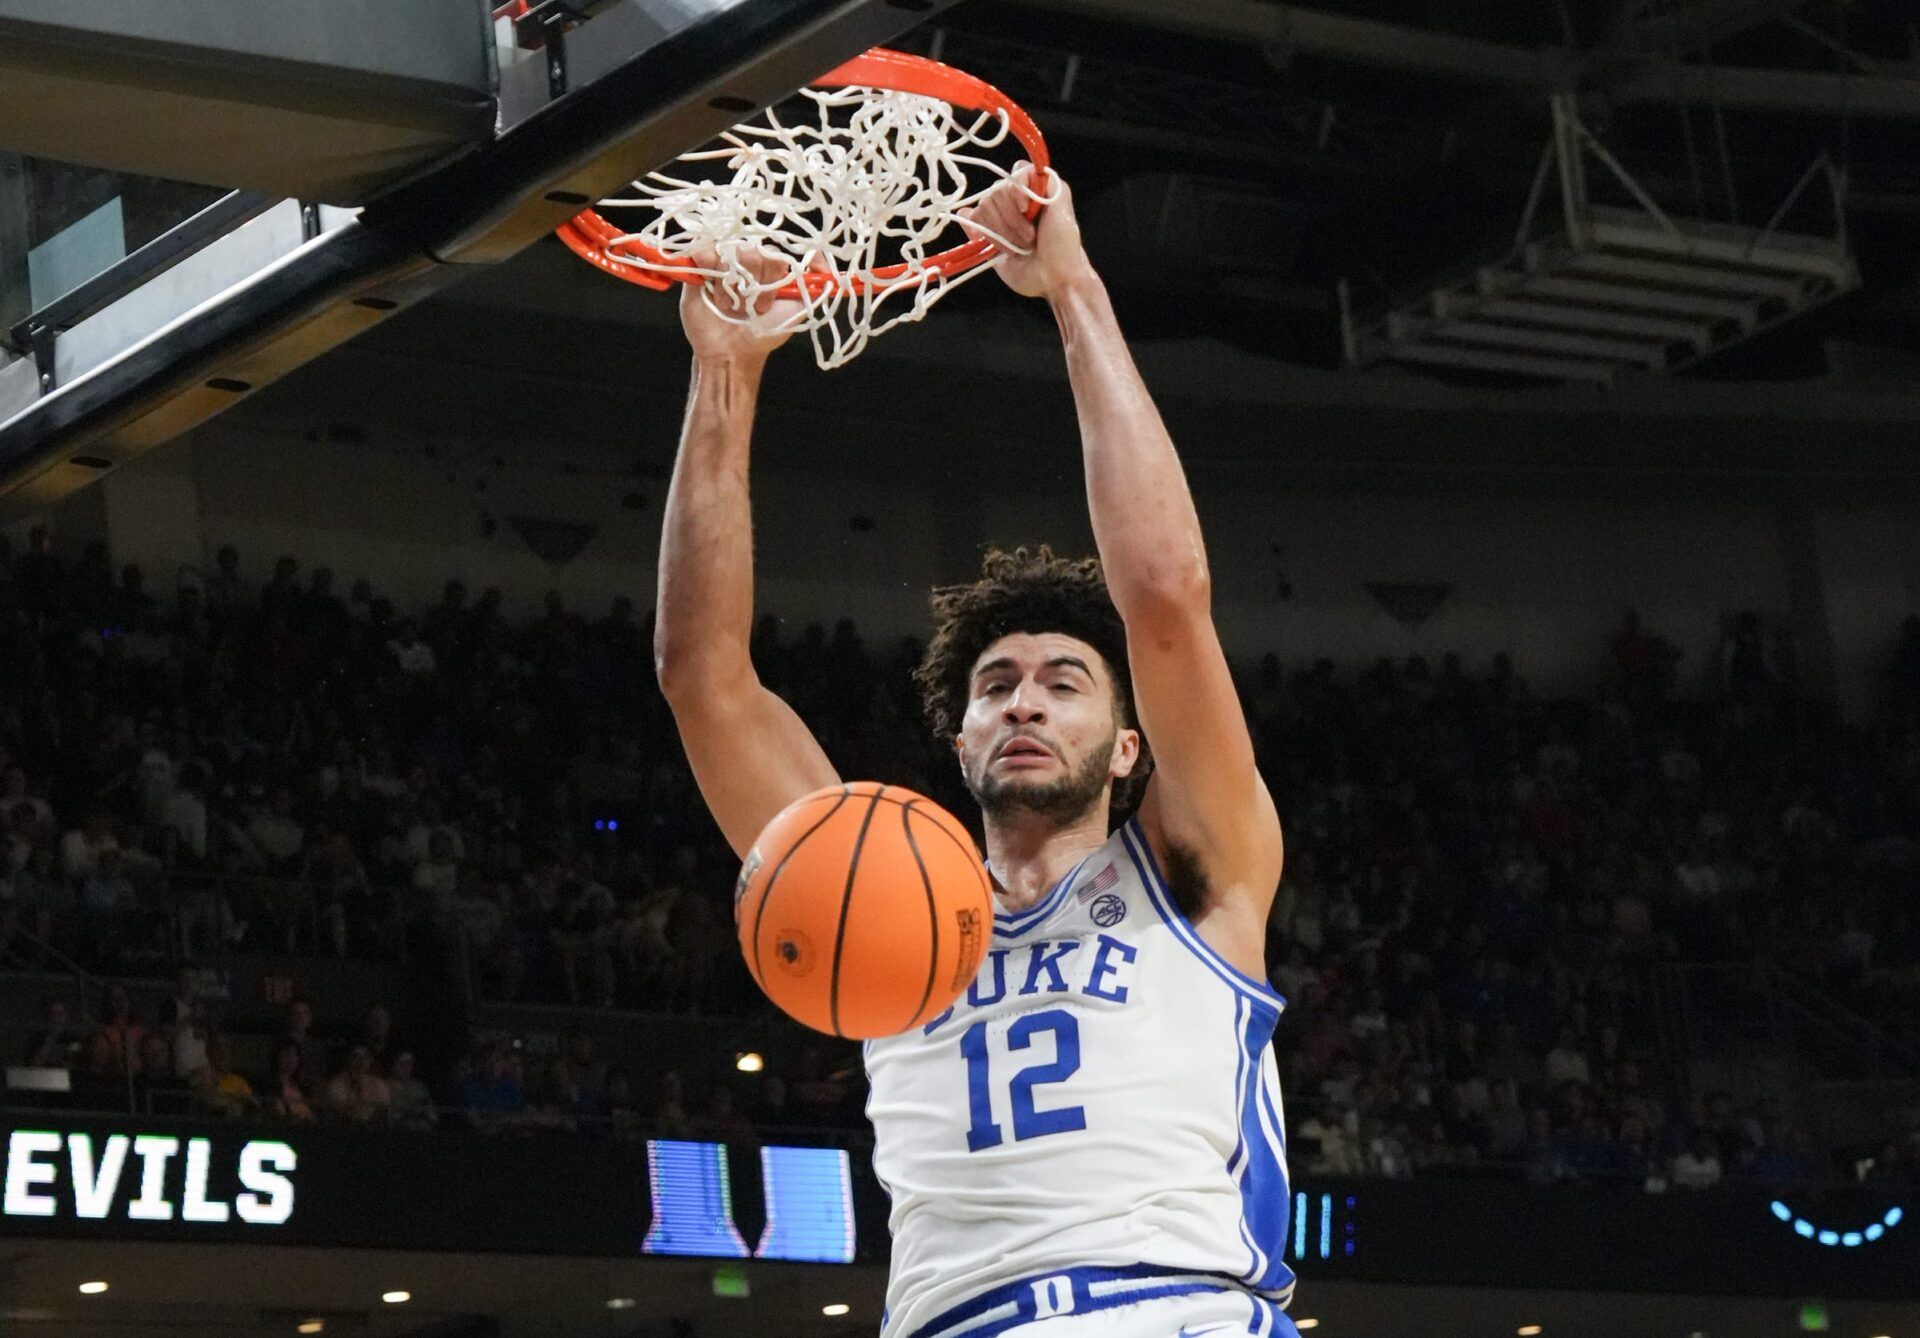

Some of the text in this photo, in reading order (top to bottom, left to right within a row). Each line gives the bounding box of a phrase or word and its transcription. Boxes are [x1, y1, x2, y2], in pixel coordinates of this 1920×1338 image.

[923, 934, 1137, 1034] UKE
[960, 1009, 1086, 1153] 12
[4, 1131, 298, 1224] EVILS
